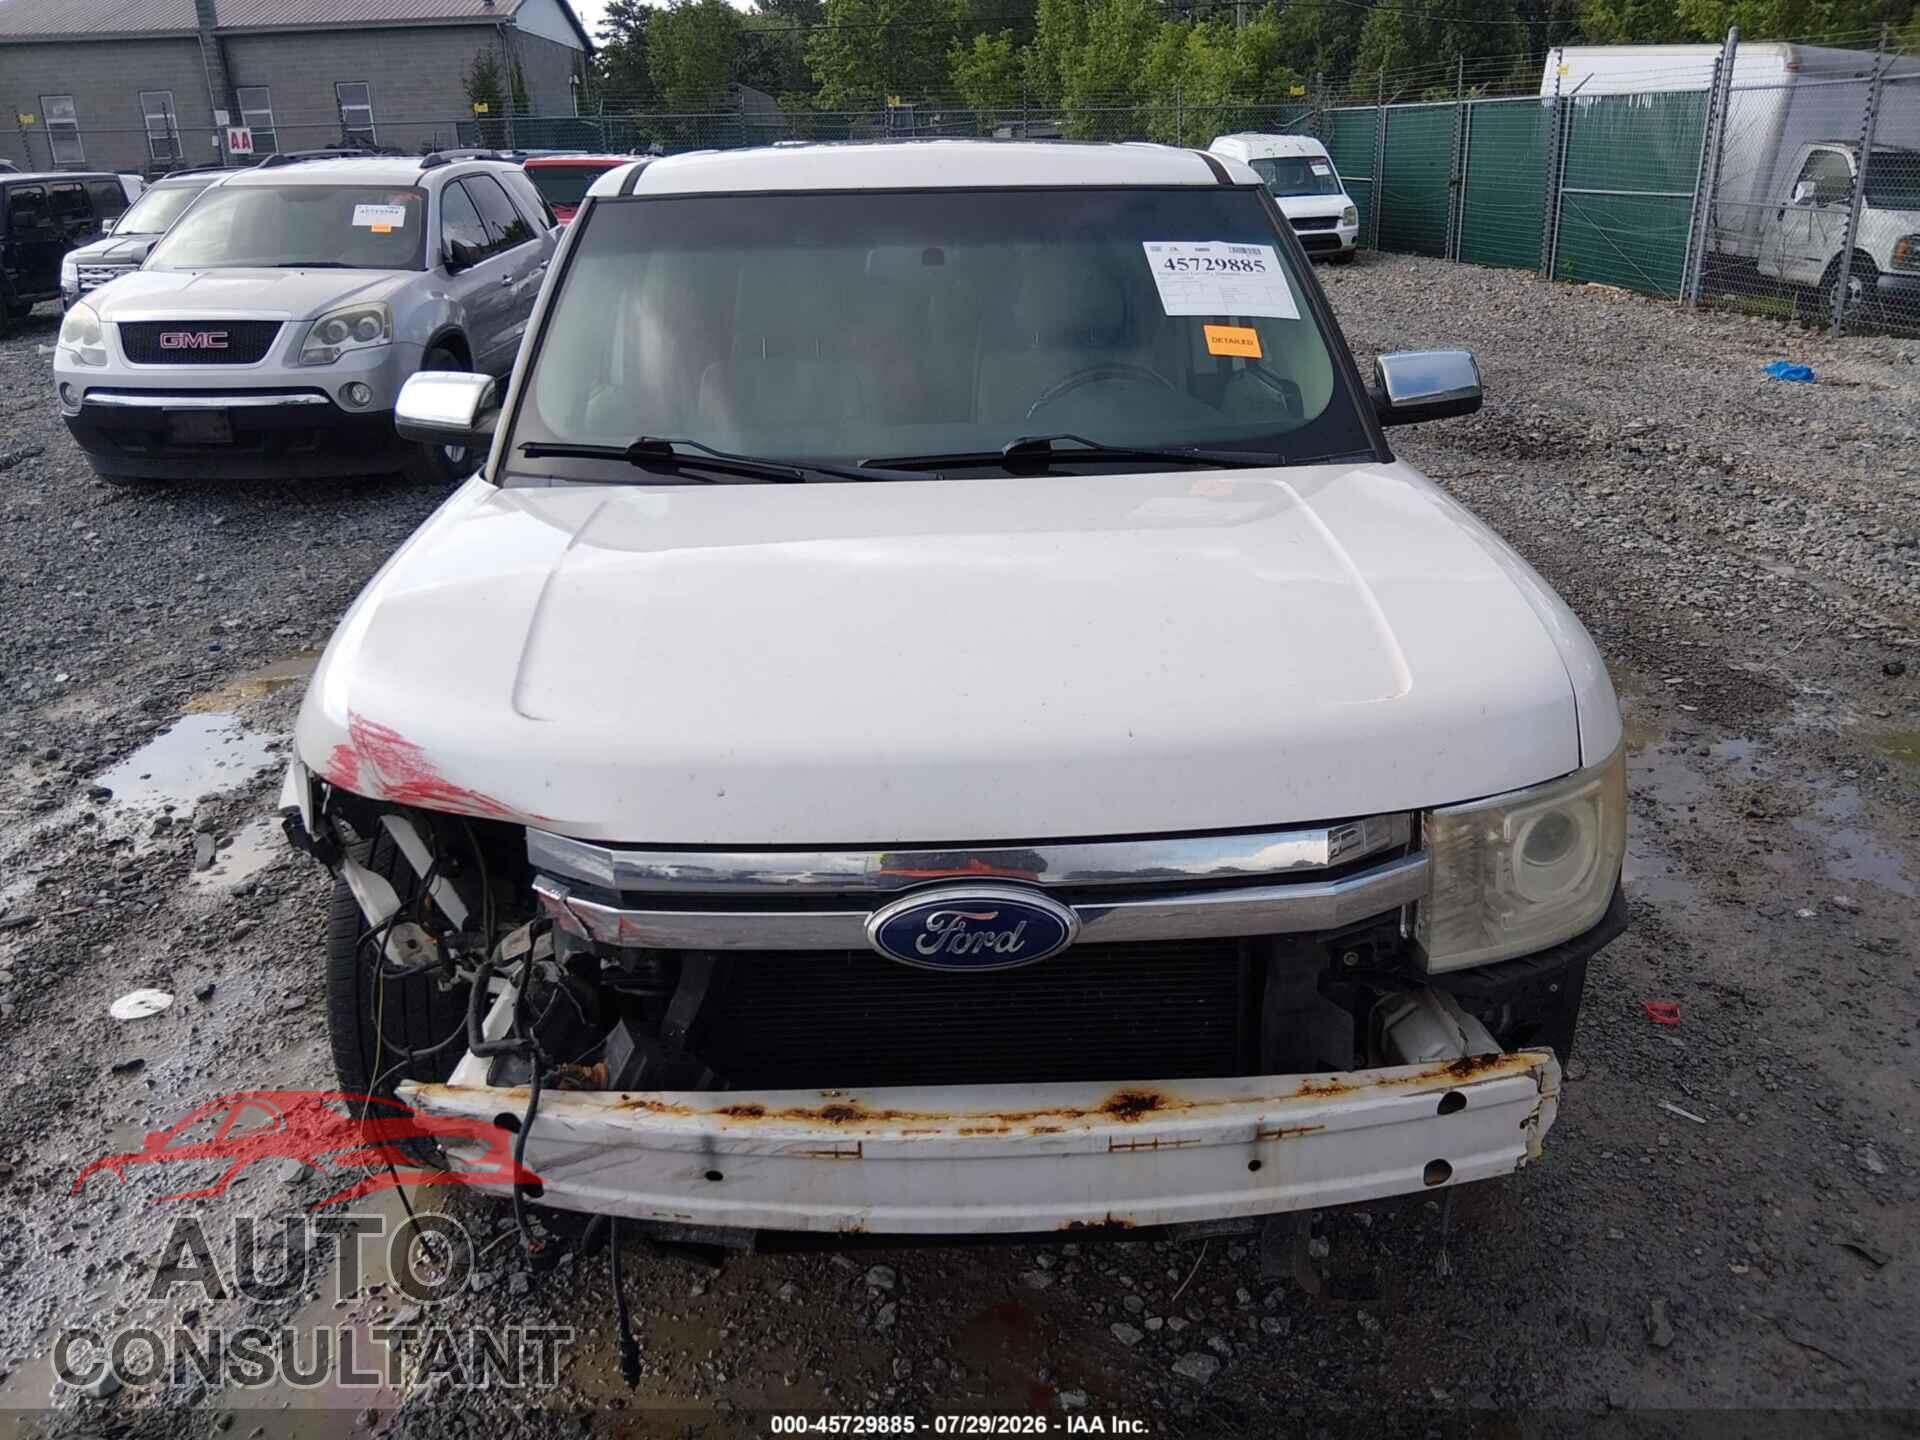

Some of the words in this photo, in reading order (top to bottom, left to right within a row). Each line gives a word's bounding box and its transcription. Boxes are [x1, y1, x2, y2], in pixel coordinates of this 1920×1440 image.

[231, 131, 251, 150] AA
[1164, 257, 1266, 273] 45729885
[160, 332, 228, 349] GMC
[1211, 336, 1254, 346] DETAILED
[915, 910, 1027, 955] Ford
